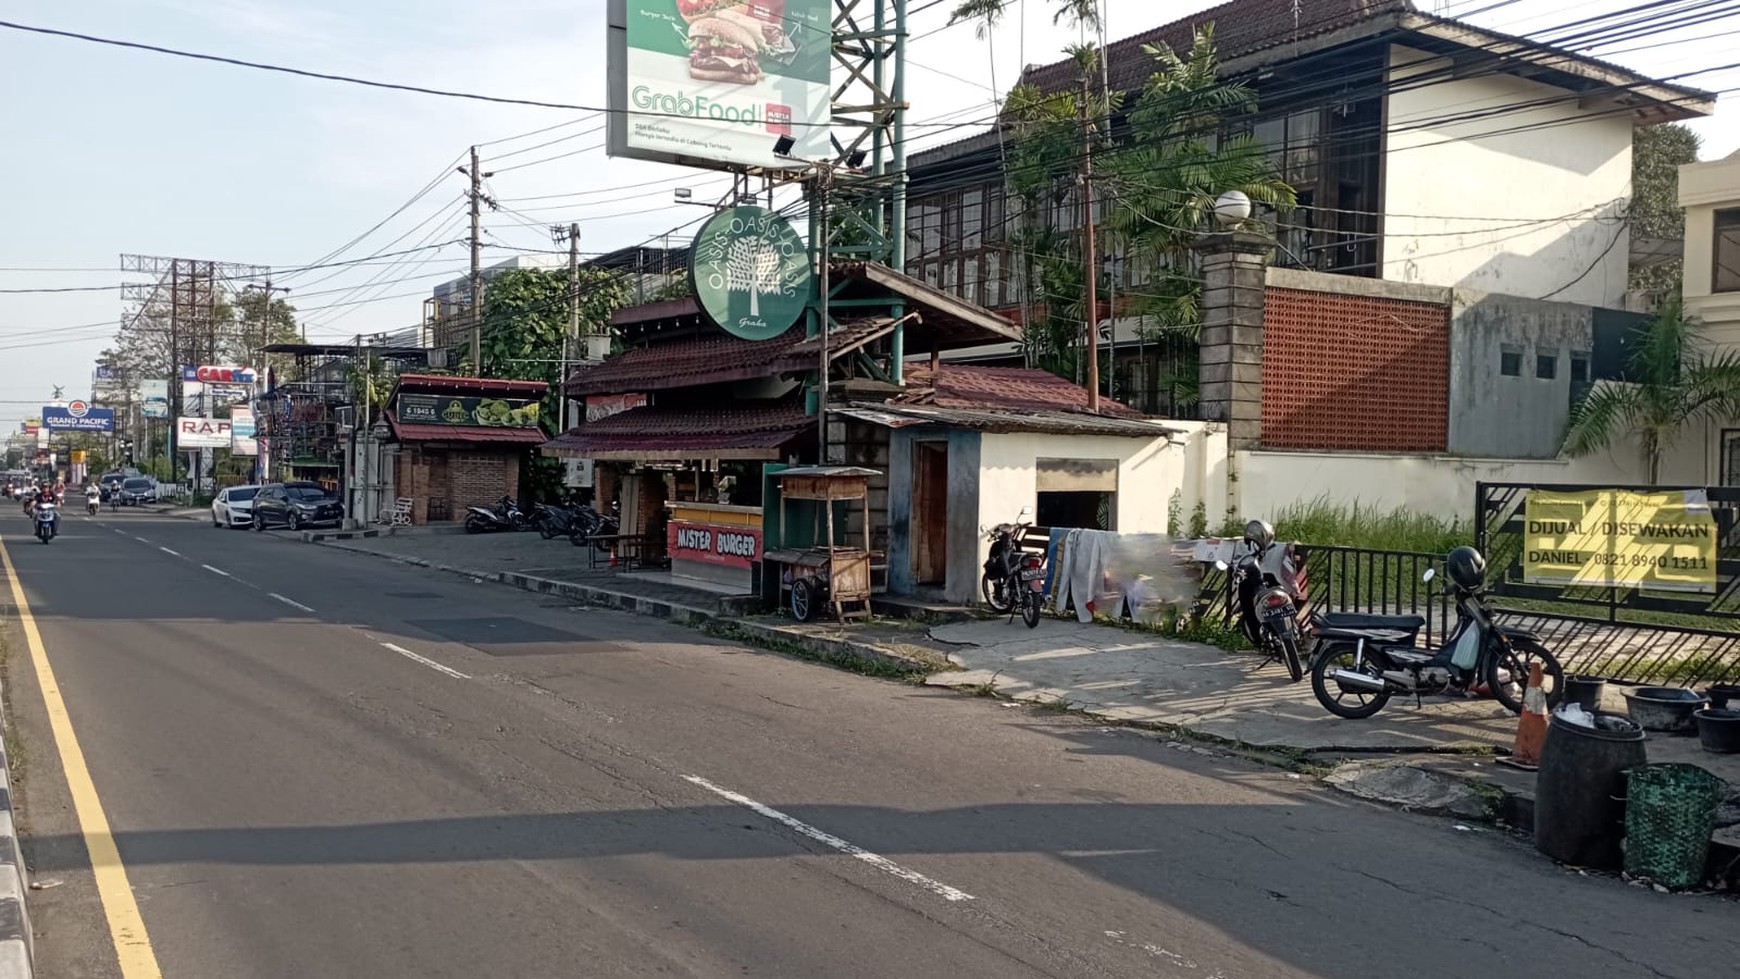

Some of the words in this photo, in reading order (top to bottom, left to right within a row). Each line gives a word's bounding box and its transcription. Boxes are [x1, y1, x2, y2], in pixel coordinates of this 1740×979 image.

[632, 85, 756, 126] GrabFood
[47, 416, 77, 425] GRAND
[79, 417, 109, 426] PACIFIC
[1529, 521, 1586, 536] DIJUAL
[1602, 522, 1709, 538] DISEWAKAN
[678, 529, 711, 550] MISTER
[717, 534, 755, 556] BURGER
[1529, 551, 1582, 565] DANIEL
[1594, 553, 1627, 566] 0821
[1631, 555, 1667, 568] 8940
[1672, 556, 1708, 570] 1511
